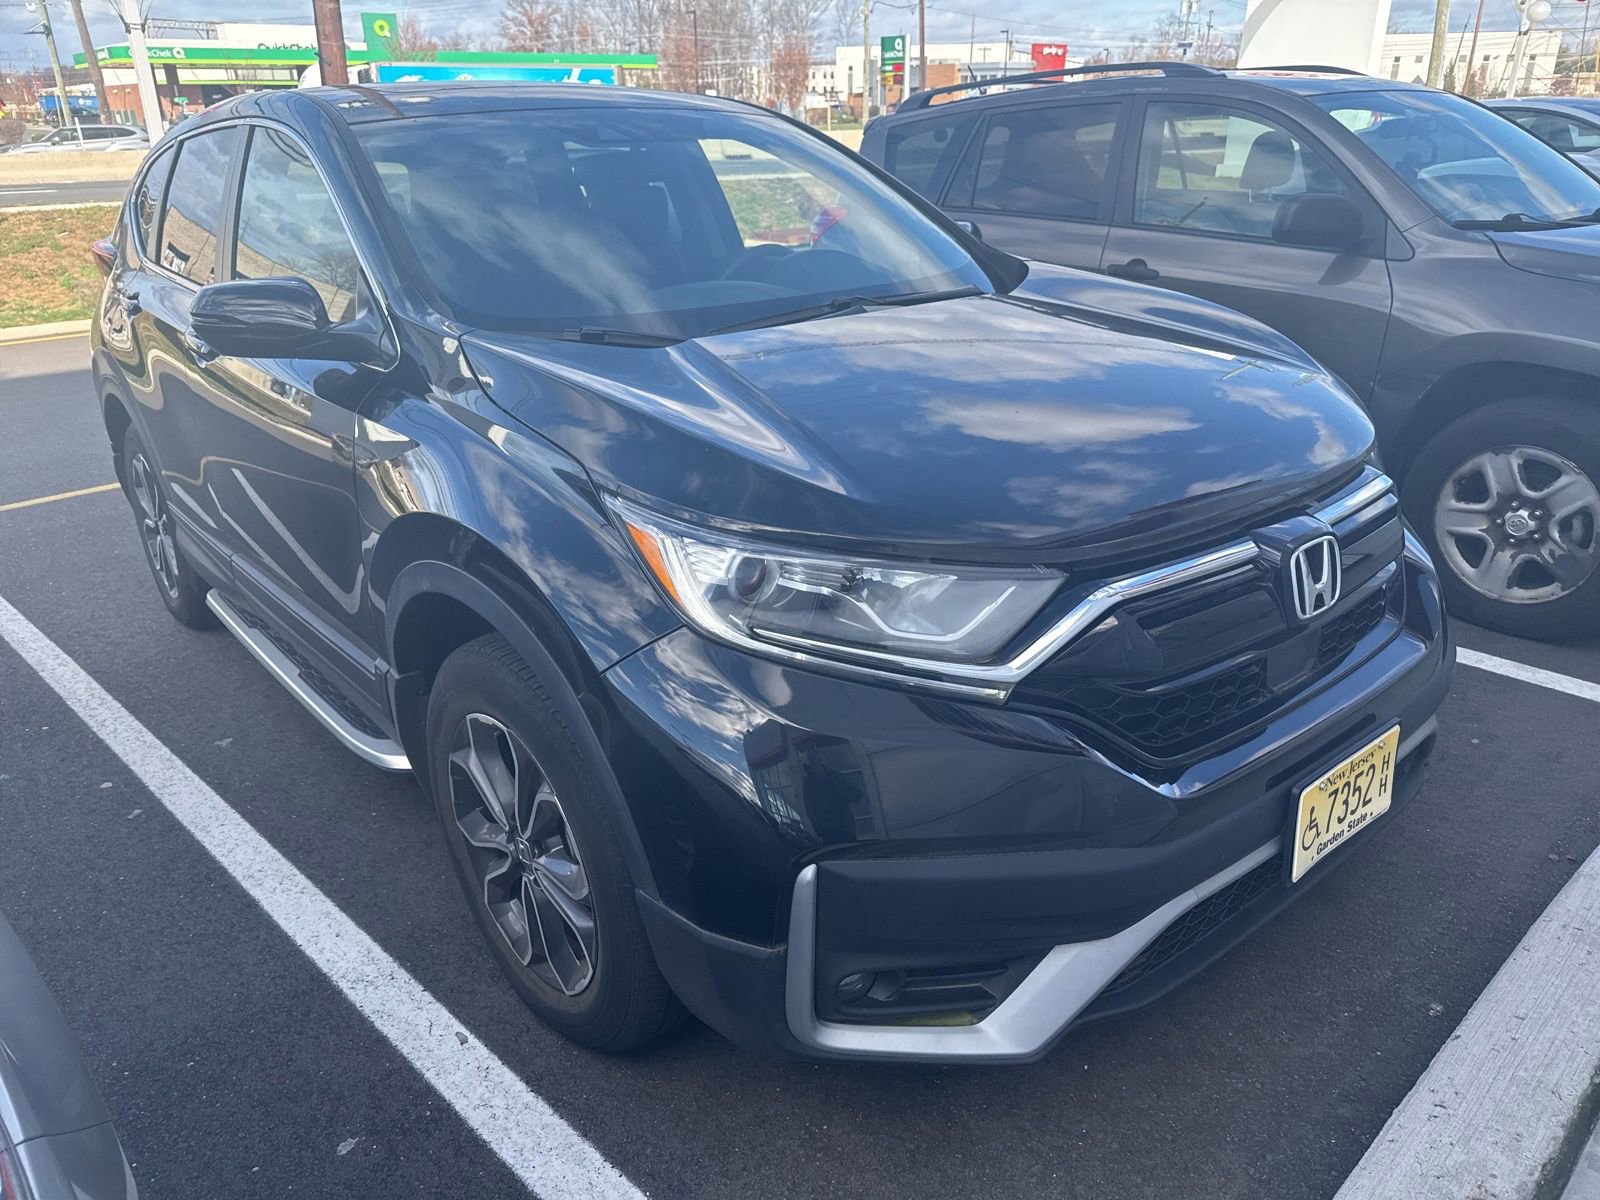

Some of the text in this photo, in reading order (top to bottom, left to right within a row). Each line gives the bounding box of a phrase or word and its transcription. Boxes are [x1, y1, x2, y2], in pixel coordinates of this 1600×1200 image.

[1325, 749, 1376, 788] New Jersey
[1326, 763, 1375, 833] 7352
[1317, 813, 1367, 855] Garden State
